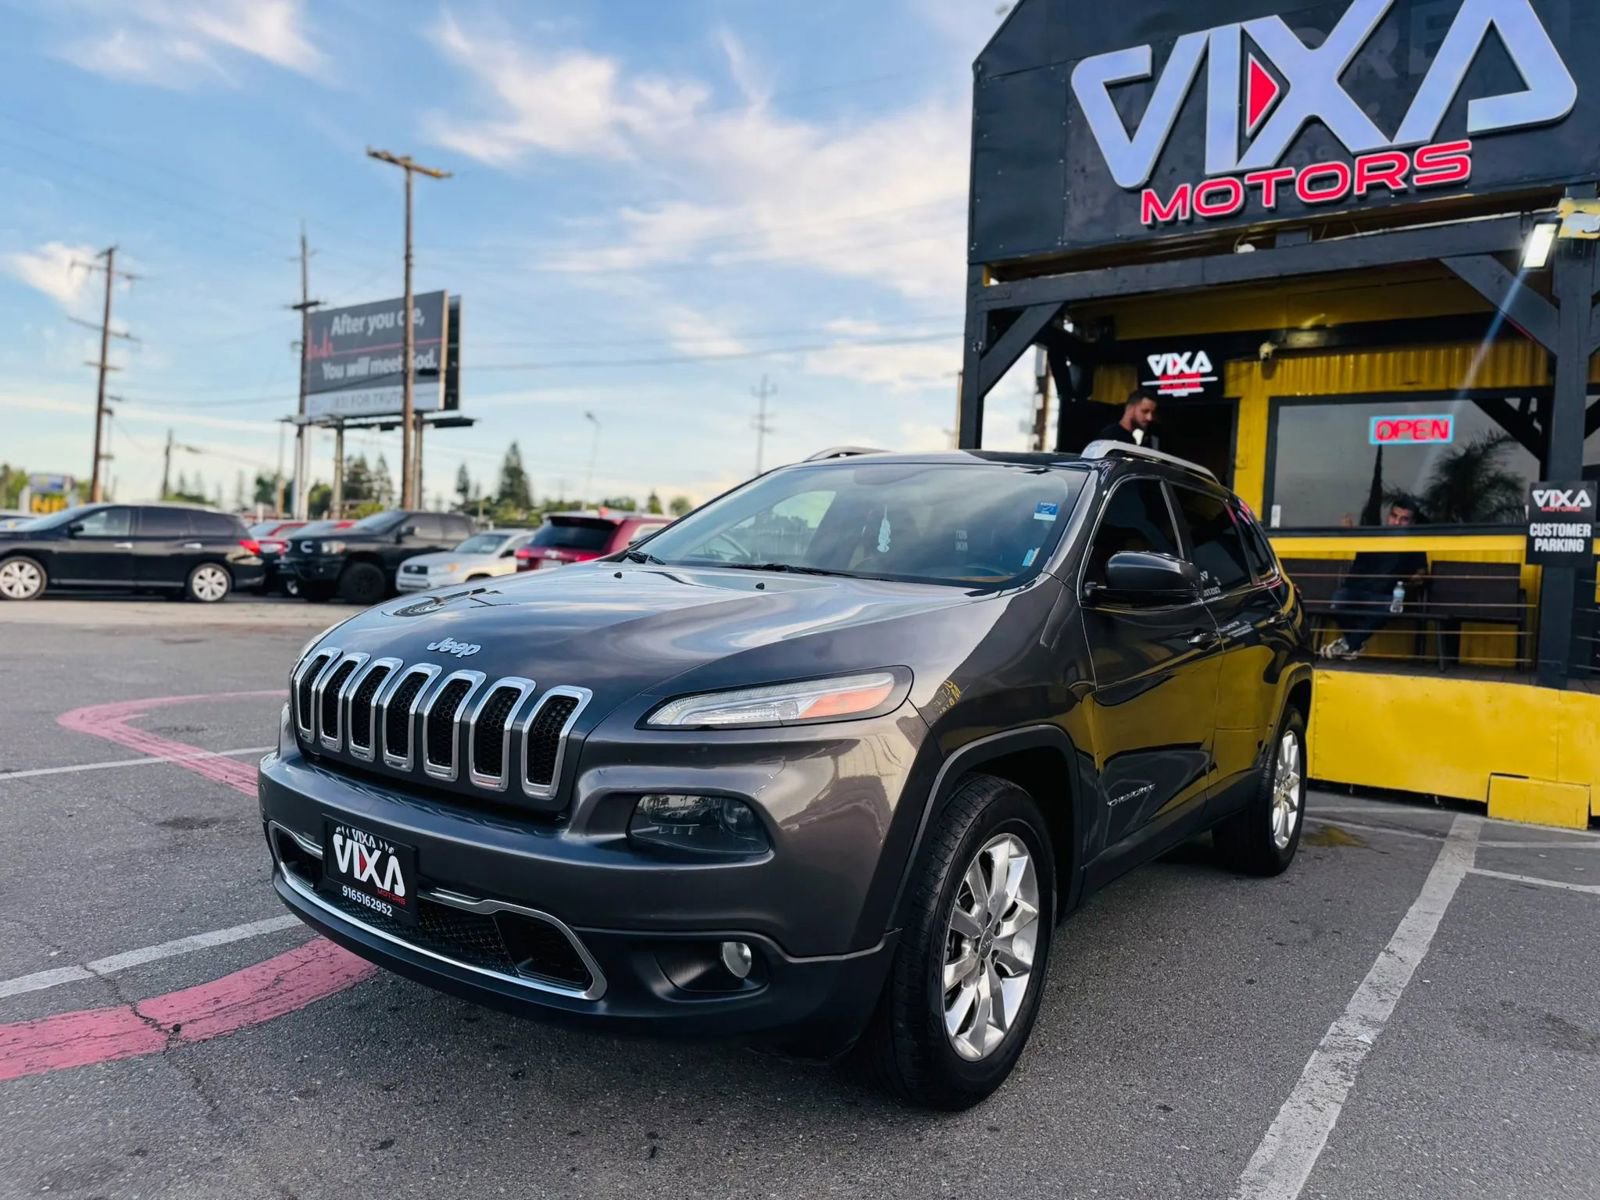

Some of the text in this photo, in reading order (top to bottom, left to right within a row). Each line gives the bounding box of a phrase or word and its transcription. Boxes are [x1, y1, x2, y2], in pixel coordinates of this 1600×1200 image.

[1071, 0, 1577, 188] VIXA
[1141, 139, 1472, 225] MOTORS
[331, 313, 365, 336] After
[367, 311, 394, 336] you
[321, 361, 344, 380] You
[347, 356, 370, 376] will
[370, 355, 404, 375] meet
[1147, 350, 1213, 376] VIXA
[1376, 419, 1449, 441] OPEN
[1532, 489, 1592, 507] VIXA
[1529, 523, 1592, 538] CUSTOMER
[1534, 538, 1585, 553] PARKING
[426, 637, 481, 658] Jeep
[351, 828, 377, 849] VIXA
[333, 833, 405, 897] VIXA
[342, 885, 393, 917] 9165162952
